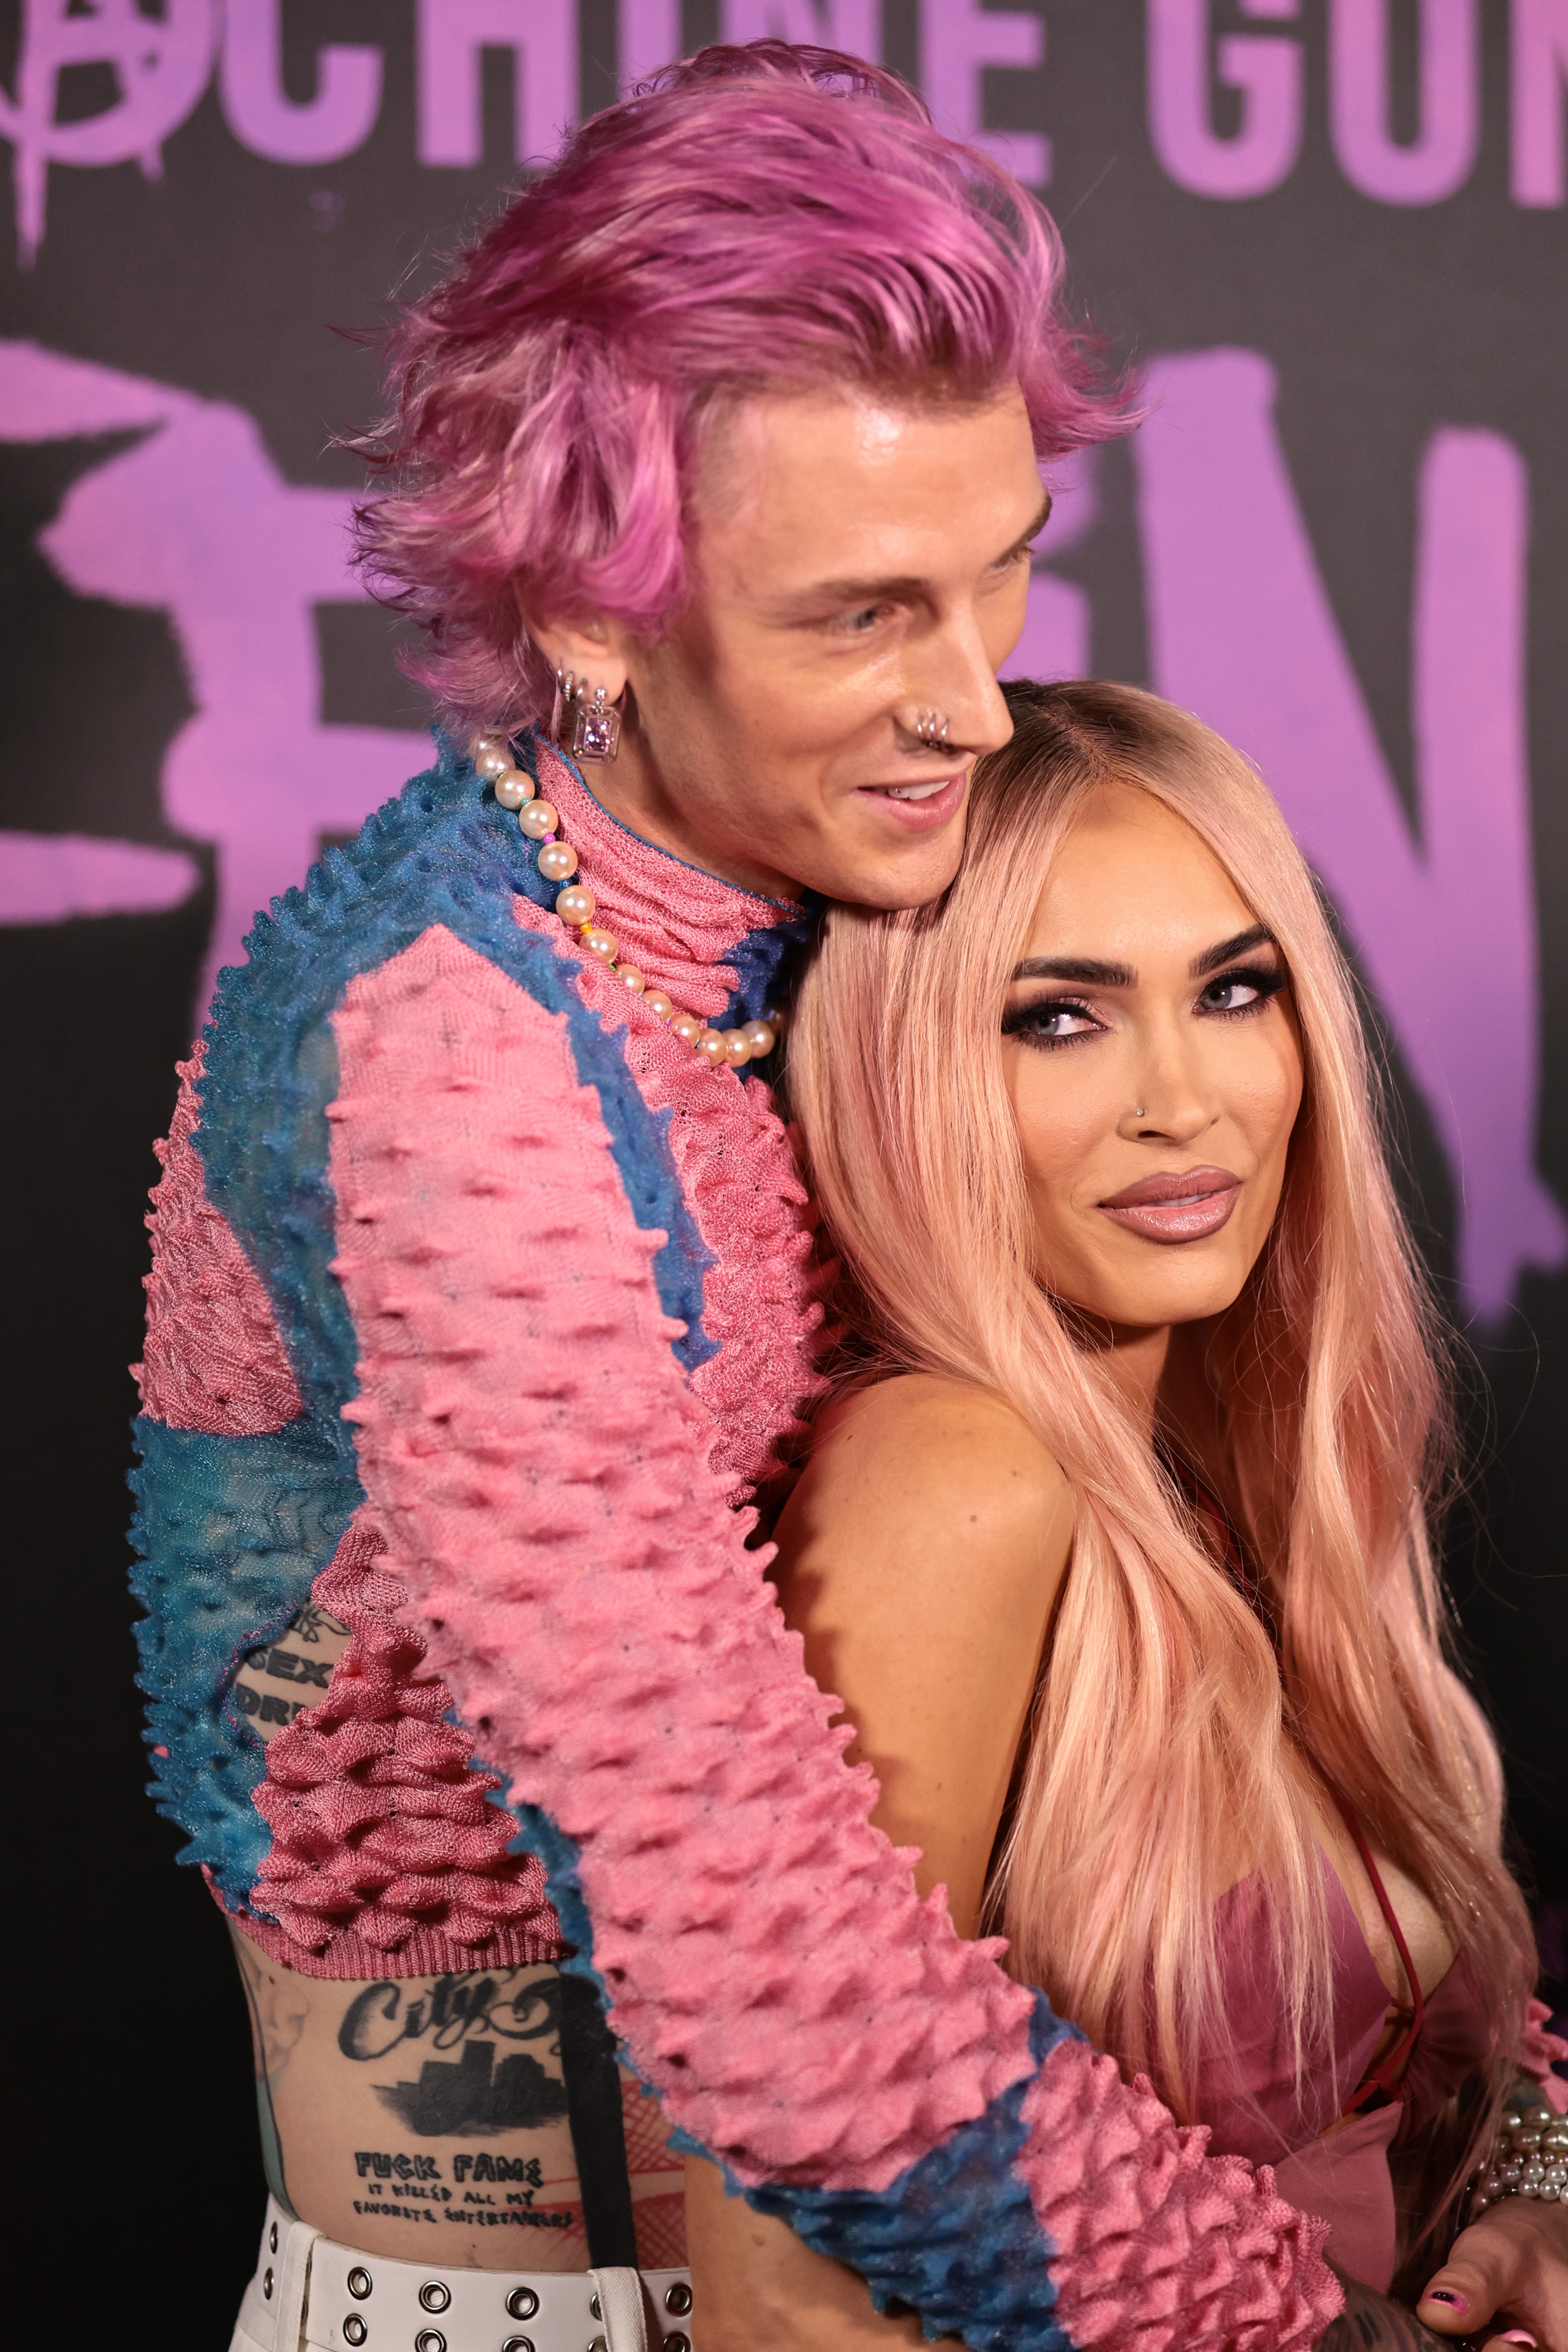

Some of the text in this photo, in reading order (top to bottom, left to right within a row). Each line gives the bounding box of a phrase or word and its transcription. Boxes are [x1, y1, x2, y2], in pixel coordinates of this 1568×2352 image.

[0, 0, 1051, 272] ACHE
[354, 2152, 544, 2188] FUCK FAME
[368, 2183, 534, 2208] IT KILLED ALL MY
[353, 2200, 437, 2223] FAVORITE
